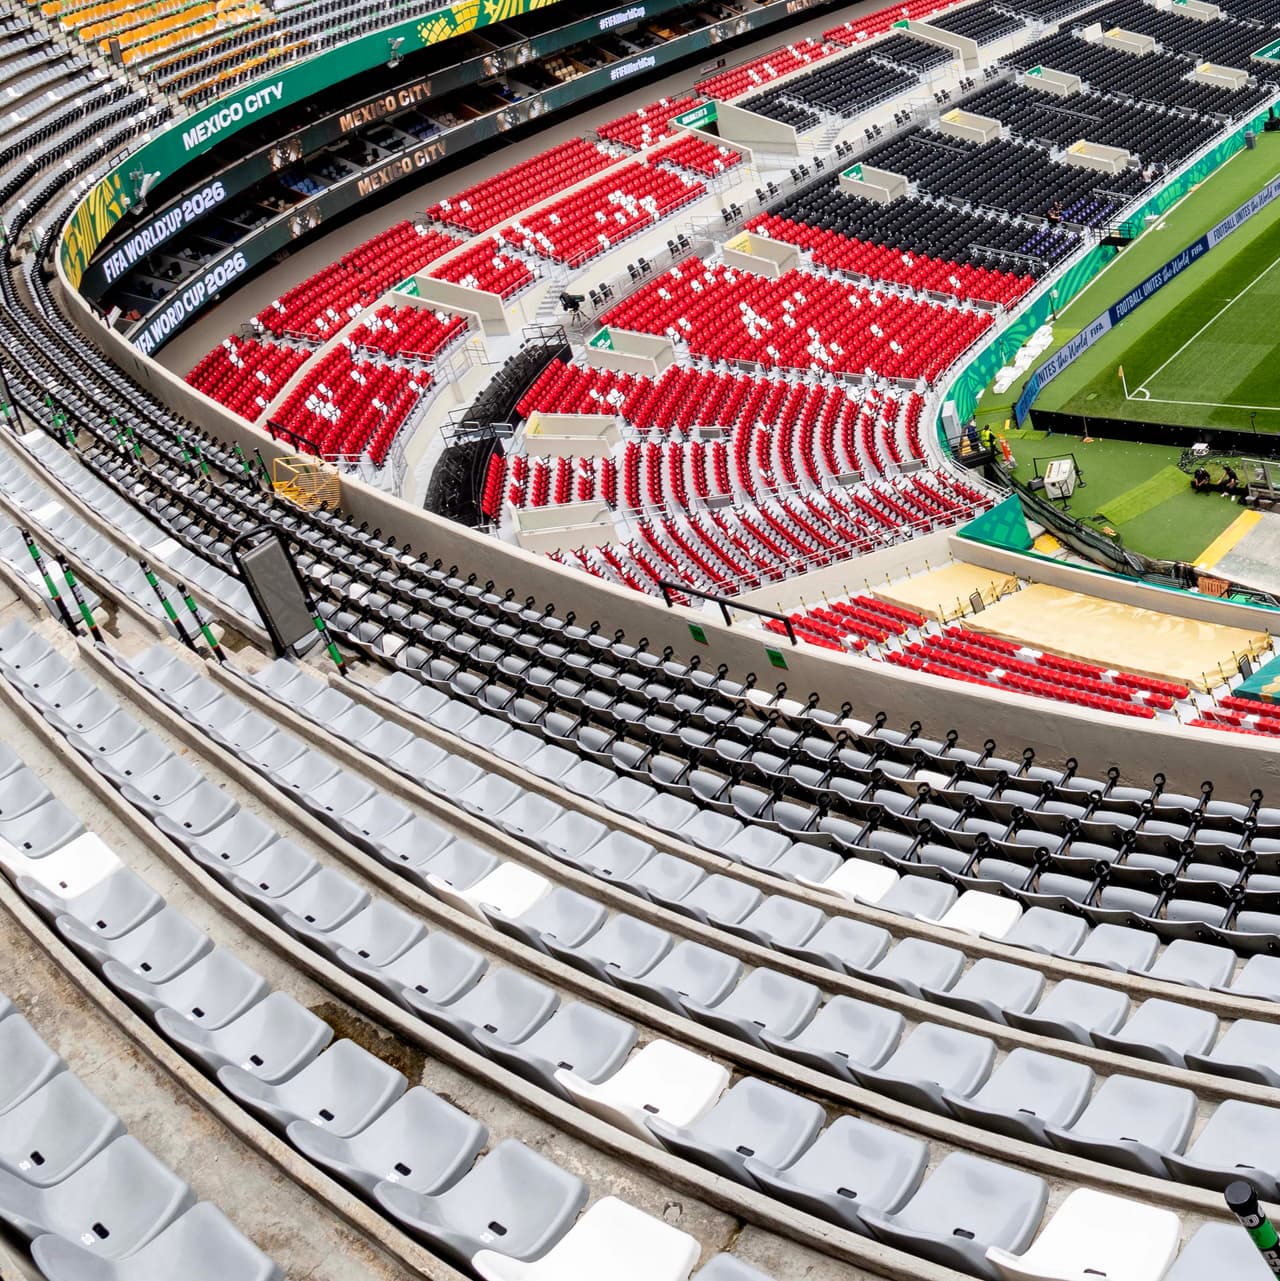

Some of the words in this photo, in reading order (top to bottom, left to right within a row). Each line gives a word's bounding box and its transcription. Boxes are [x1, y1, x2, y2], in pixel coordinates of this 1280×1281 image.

[182, 102, 244, 151] MEXICO
[245, 81, 284, 113] CITY
[339, 98, 398, 133] MEXICO
[398, 82, 433, 111] CITY
[357, 160, 413, 197] MEXICO
[414, 140, 447, 167] CITY
[102, 251, 128, 283] FIFA
[124, 222, 167, 263] WORLD
[163, 208, 182, 236] UP
[182, 181, 225, 222] 2026
[1214, 217, 1236, 241] FOOTBALL
[1235, 205, 1251, 228] UNITES
[182, 282, 206, 315] CUP
[205, 252, 246, 295] 2026
[1116, 290, 1143, 318] FOOTBALL
[1143, 273, 1162, 300] UNITES
[1172, 251, 1190, 275] World
[1191, 244, 1204, 259] FIFA
[1057, 351, 1068, 371] the
[1068, 331, 1089, 359] World
[1090, 322, 1104, 338] FIFA
